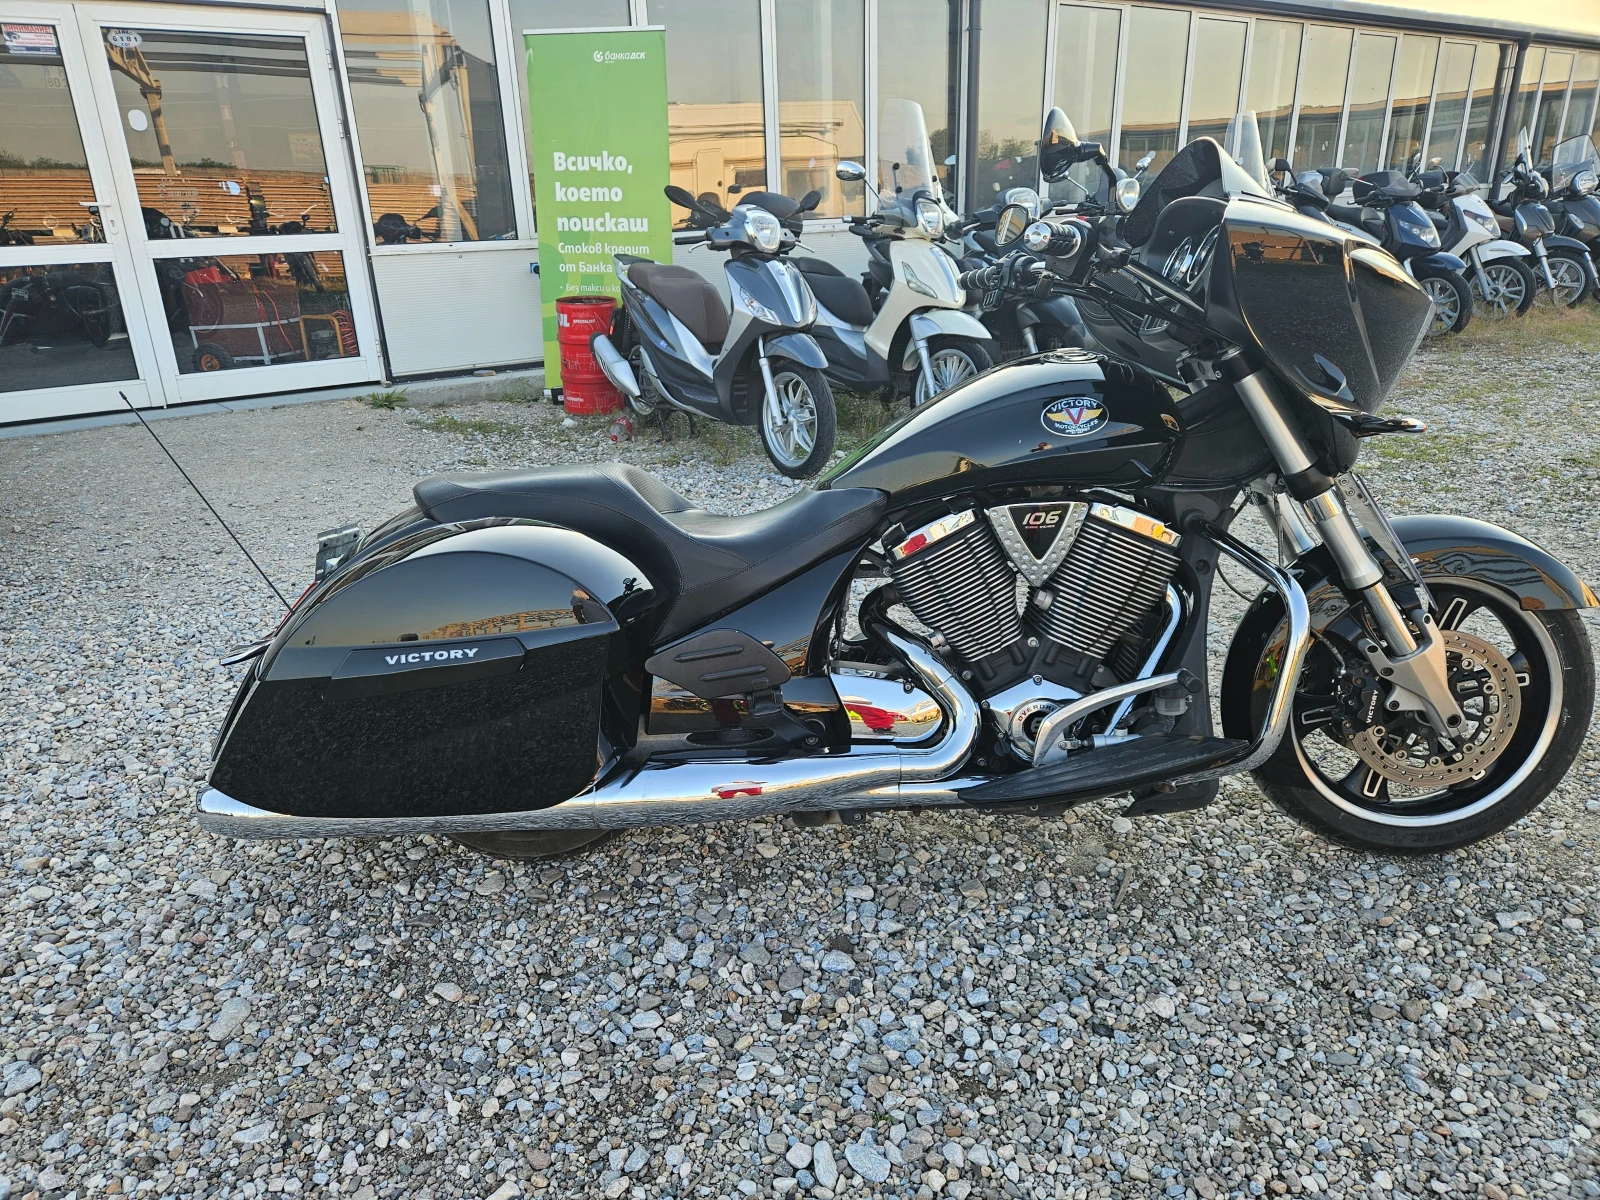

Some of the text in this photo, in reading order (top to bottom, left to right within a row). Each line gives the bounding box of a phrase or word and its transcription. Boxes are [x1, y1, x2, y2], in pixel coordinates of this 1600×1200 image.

[553, 150, 633, 174] Всичко,
[555, 181, 623, 202] което
[557, 212, 649, 233] поискаш
[558, 242, 650, 255] Стоков кредит
[559, 264, 577, 273] от
[578, 262, 613, 273] Банка
[580, 283, 604, 292] такси
[1051, 399, 1098, 412] VICTORY
[1054, 418, 1098, 430] MOTORCYCLES
[1022, 510, 1062, 525] 106
[385, 648, 478, 665] VICTORY
[1366, 689, 1379, 723] VICTORY
